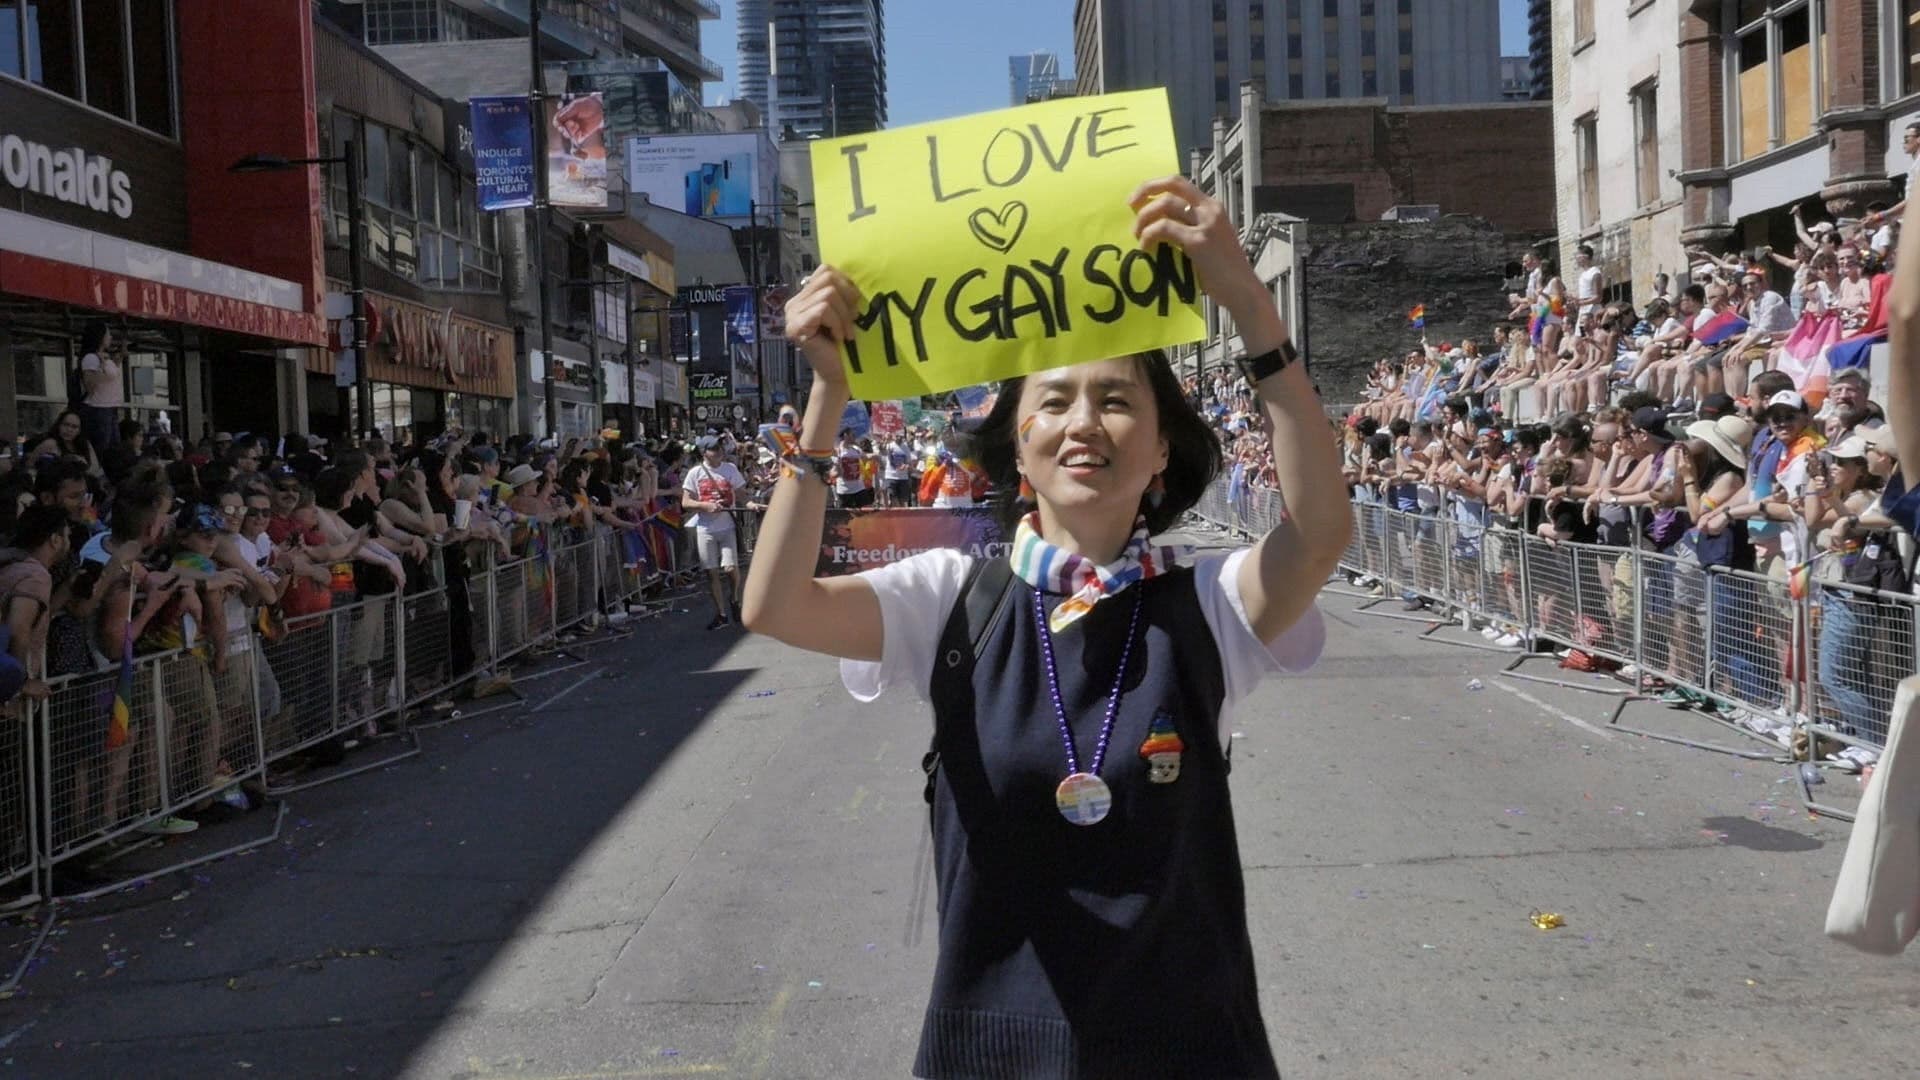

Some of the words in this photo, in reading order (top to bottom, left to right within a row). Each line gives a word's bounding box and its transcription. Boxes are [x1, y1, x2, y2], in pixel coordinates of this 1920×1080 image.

[477, 147, 523, 158] INDULGE
[497, 158, 509, 167] IN
[840, 142, 877, 222] I
[926, 106, 1139, 202] LOVE
[0, 133, 133, 219] onald's
[478, 165, 534, 178] TORONTO'S
[476, 175, 526, 187] CULTURAL
[496, 183, 529, 195] HEART
[689, 288, 727, 304] LOUNGE
[843, 276, 937, 374] MY
[944, 246, 1072, 343] GAY
[1083, 241, 1196, 325] SON
